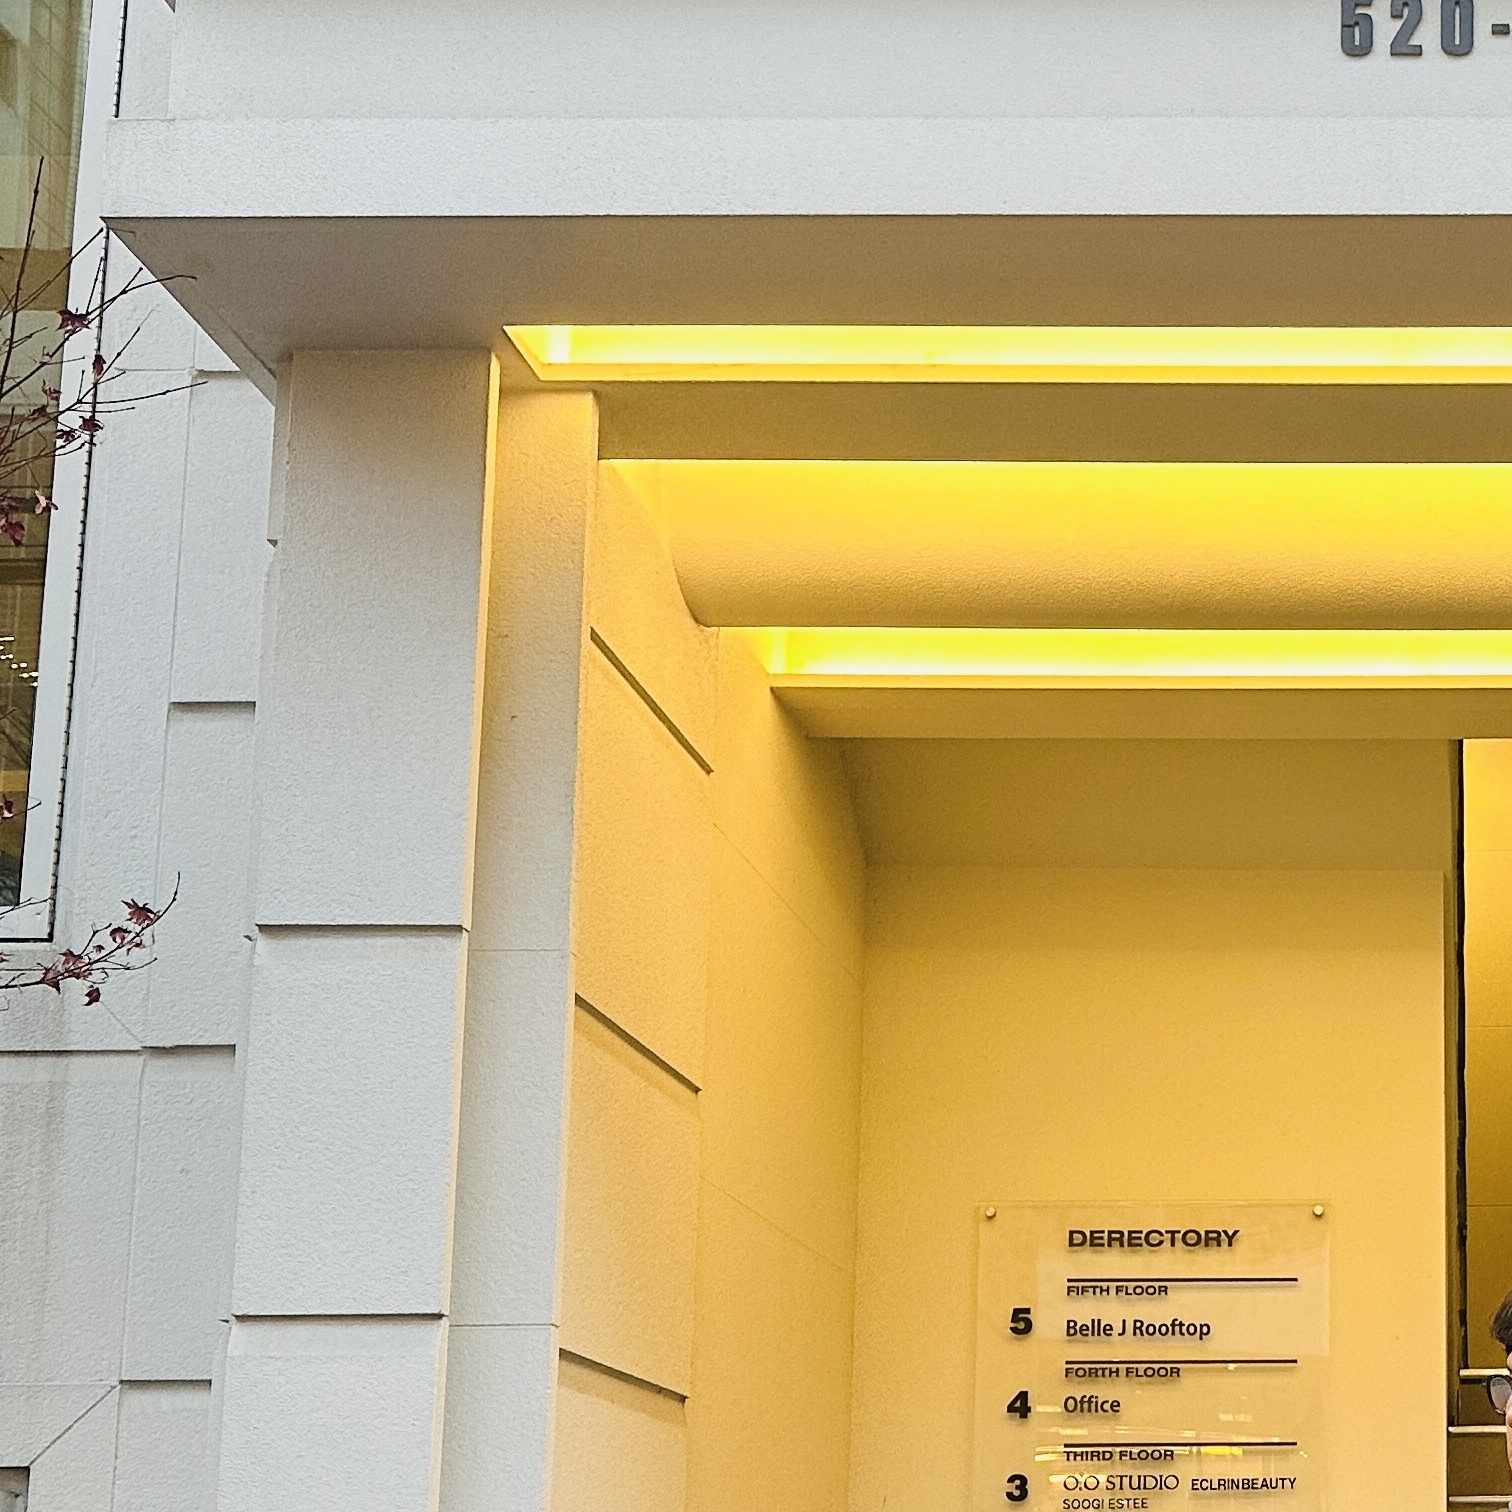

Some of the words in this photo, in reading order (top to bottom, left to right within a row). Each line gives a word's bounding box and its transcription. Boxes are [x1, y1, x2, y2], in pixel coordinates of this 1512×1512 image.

[1067, 1229, 1239, 1248] DERECTORY
[1066, 1285, 1110, 1296] FIFTH
[1115, 1285, 1168, 1296] FLOOR
[1009, 1307, 1033, 1335] 5
[1066, 1319, 1114, 1337] Belle
[1117, 1319, 1127, 1337] J
[1132, 1319, 1212, 1341] Rooftop
[1064, 1366, 1120, 1379] FORTH
[1125, 1366, 1181, 1378] FLOOR
[1006, 1390, 1032, 1419] 4
[1063, 1395, 1121, 1413] Office
[1063, 1449, 1114, 1462] THIRD
[1118, 1449, 1174, 1461] FLOOR
[1005, 1474, 1029, 1502] 3
[1105, 1474, 1180, 1491] STUDIO
[1062, 1498, 1105, 1510] SOOGI
[1108, 1497, 1149, 1509] ESTEE
